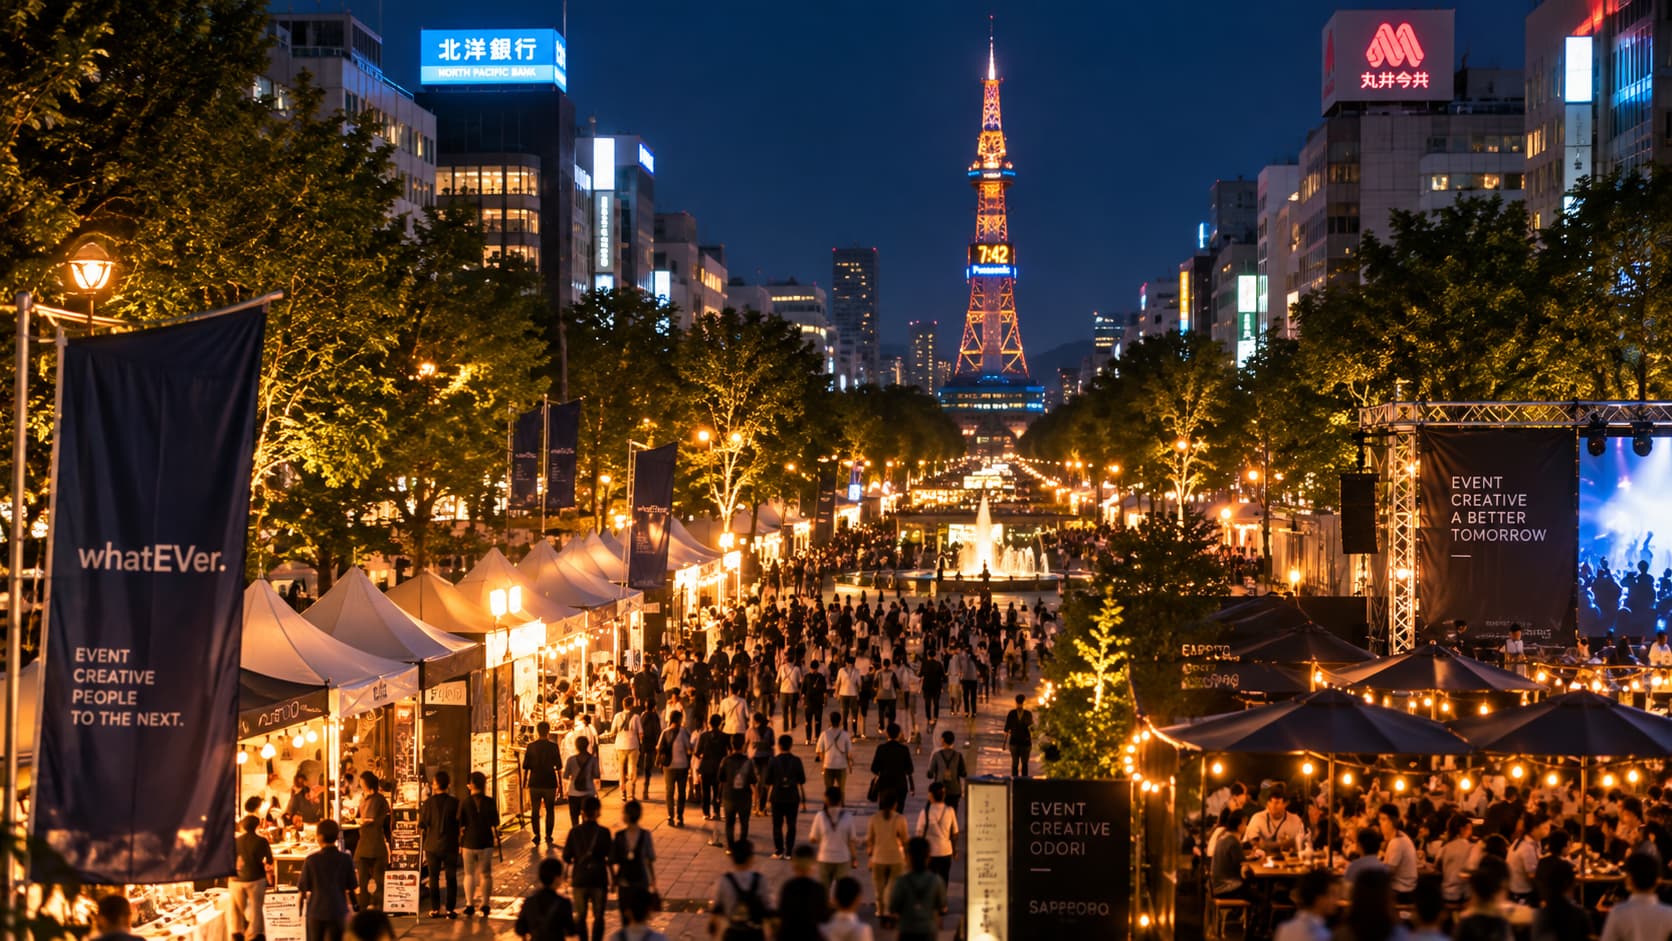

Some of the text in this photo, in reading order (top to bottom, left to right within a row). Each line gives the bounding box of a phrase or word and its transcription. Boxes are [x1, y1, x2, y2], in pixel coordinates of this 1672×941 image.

[438, 38, 537, 60] 北洋銀行
[438, 67, 536, 77] NORTH PACIFIC BANK
[978, 245, 1008, 264] 7:42
[1451, 476, 1503, 489] EVENT
[1451, 494, 1527, 507] CREATIVE
[1451, 511, 1526, 524] A BETTER
[1451, 528, 1547, 542] TOMORROW
[78, 541, 226, 572] whatEVer.
[75, 647, 130, 663] EVENT
[73, 668, 155, 685] CREATIVE
[72, 689, 137, 705] PEOPLE
[71, 710, 184, 727] TO THE NEXT.
[1030, 802, 1086, 816] EVENT
[1030, 821, 1111, 836] CREATIVE
[1030, 841, 1085, 856] ODORI
